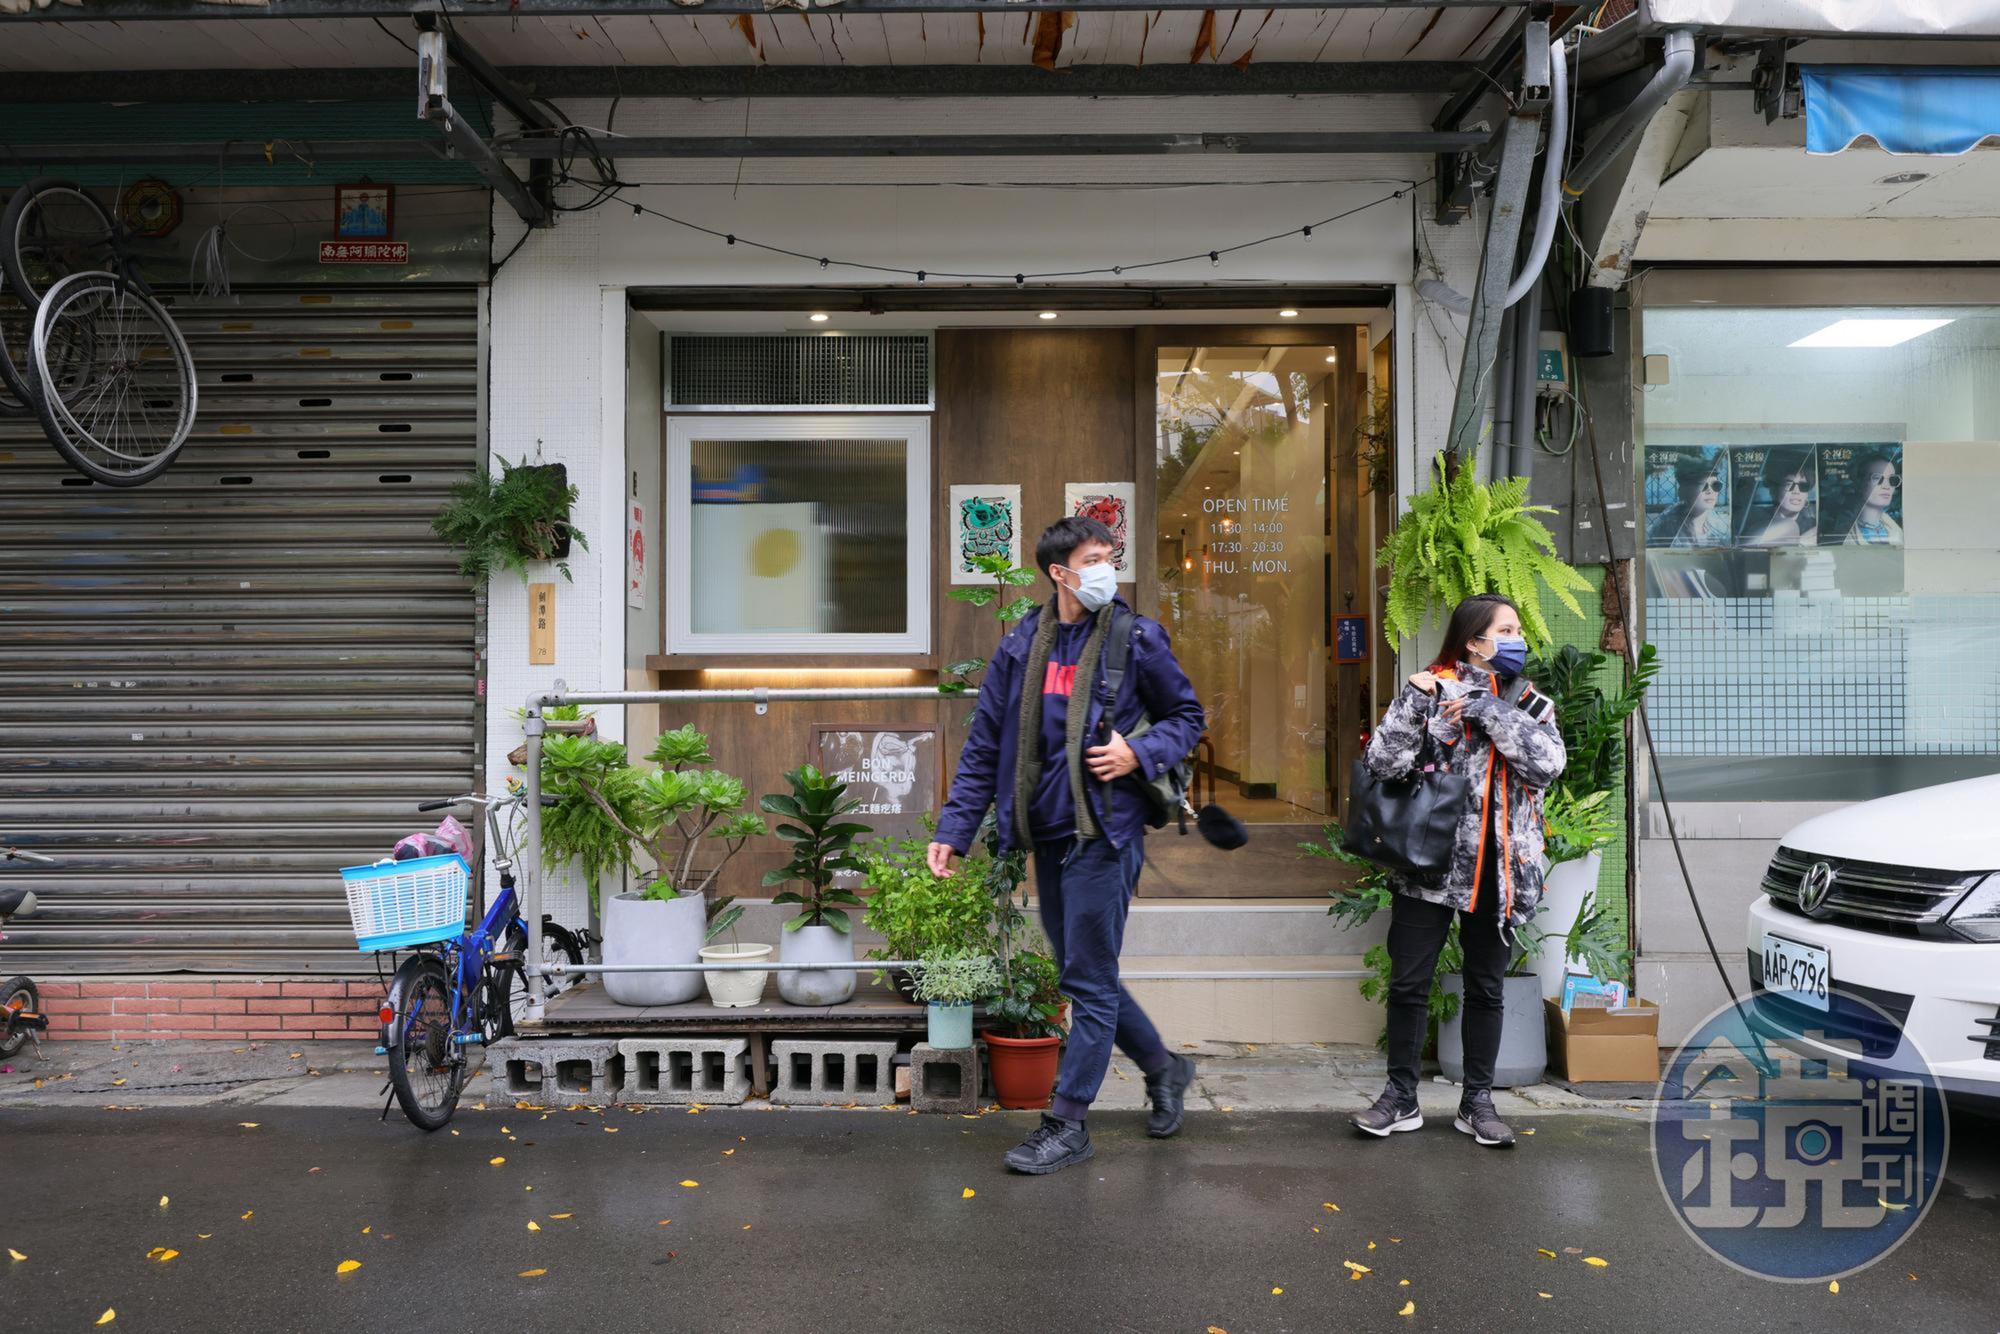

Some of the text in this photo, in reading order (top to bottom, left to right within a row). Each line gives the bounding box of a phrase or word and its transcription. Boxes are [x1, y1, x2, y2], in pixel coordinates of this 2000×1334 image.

[322, 245, 406, 258] 南無阿彌陀佛
[1203, 498, 1289, 513] OPEN TIME
[1211, 523, 1242, 534] 11:30
[1253, 523, 1283, 534] 14:00
[1211, 542, 1242, 553] 17:30
[1252, 541, 1284, 553] 20:30
[1203, 560, 1239, 574] THU.
[1252, 560, 1292, 574] MON.
[537, 647, 547, 656] 78
[862, 758, 892, 770] BON
[836, 771, 916, 783] MEINGERDA
